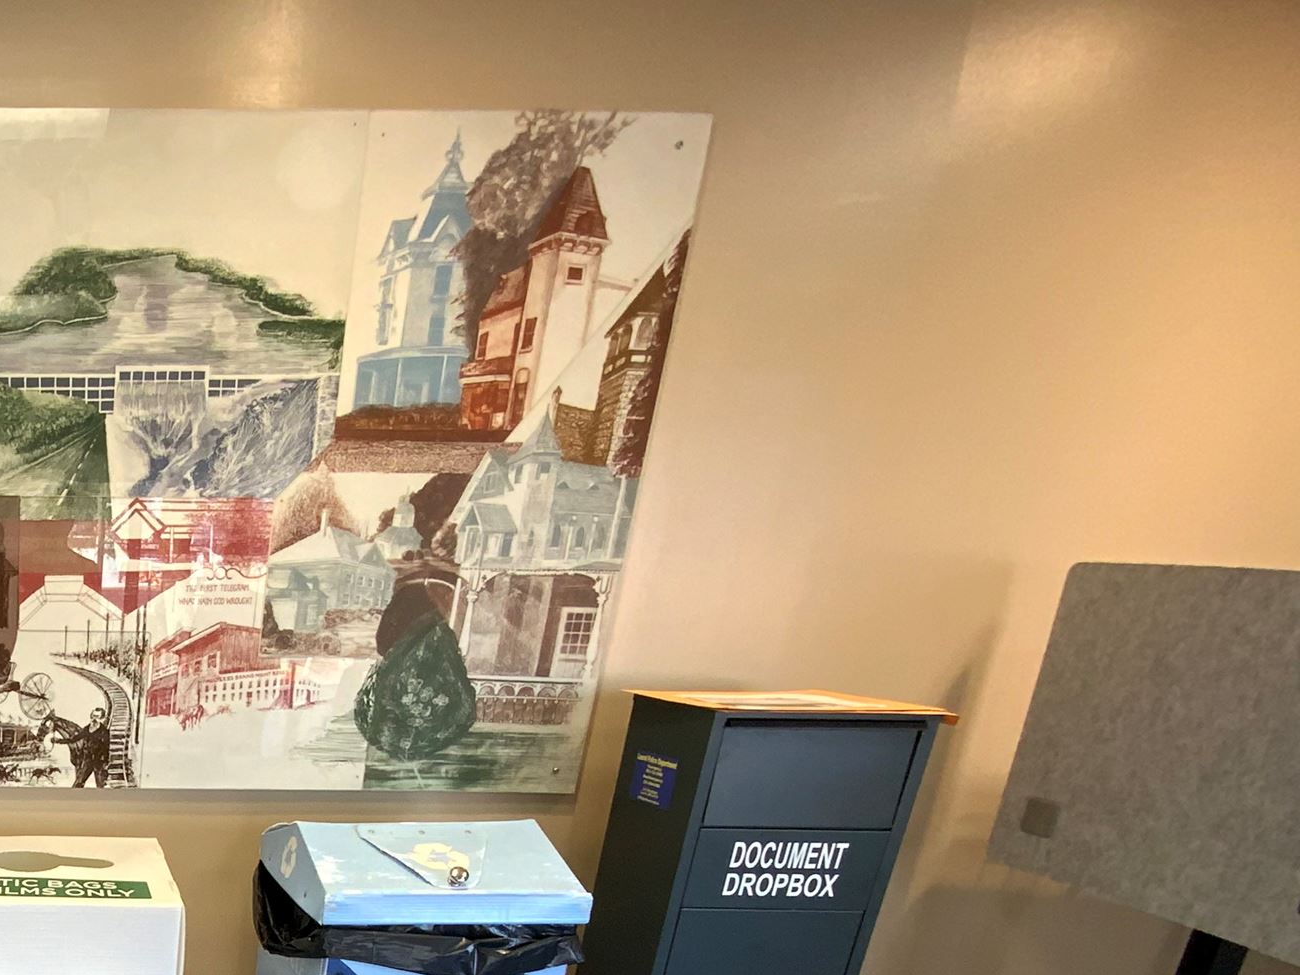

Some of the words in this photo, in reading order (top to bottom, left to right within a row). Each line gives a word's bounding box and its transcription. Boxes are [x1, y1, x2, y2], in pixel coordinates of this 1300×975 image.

[220, 584, 249, 592] TELEGRAM
[728, 841, 850, 869] DOCUMENT
[47, 879, 118, 890] BAGS
[721, 872, 840, 898] DROPBOX
[64, 888, 135, 898] ONLY
